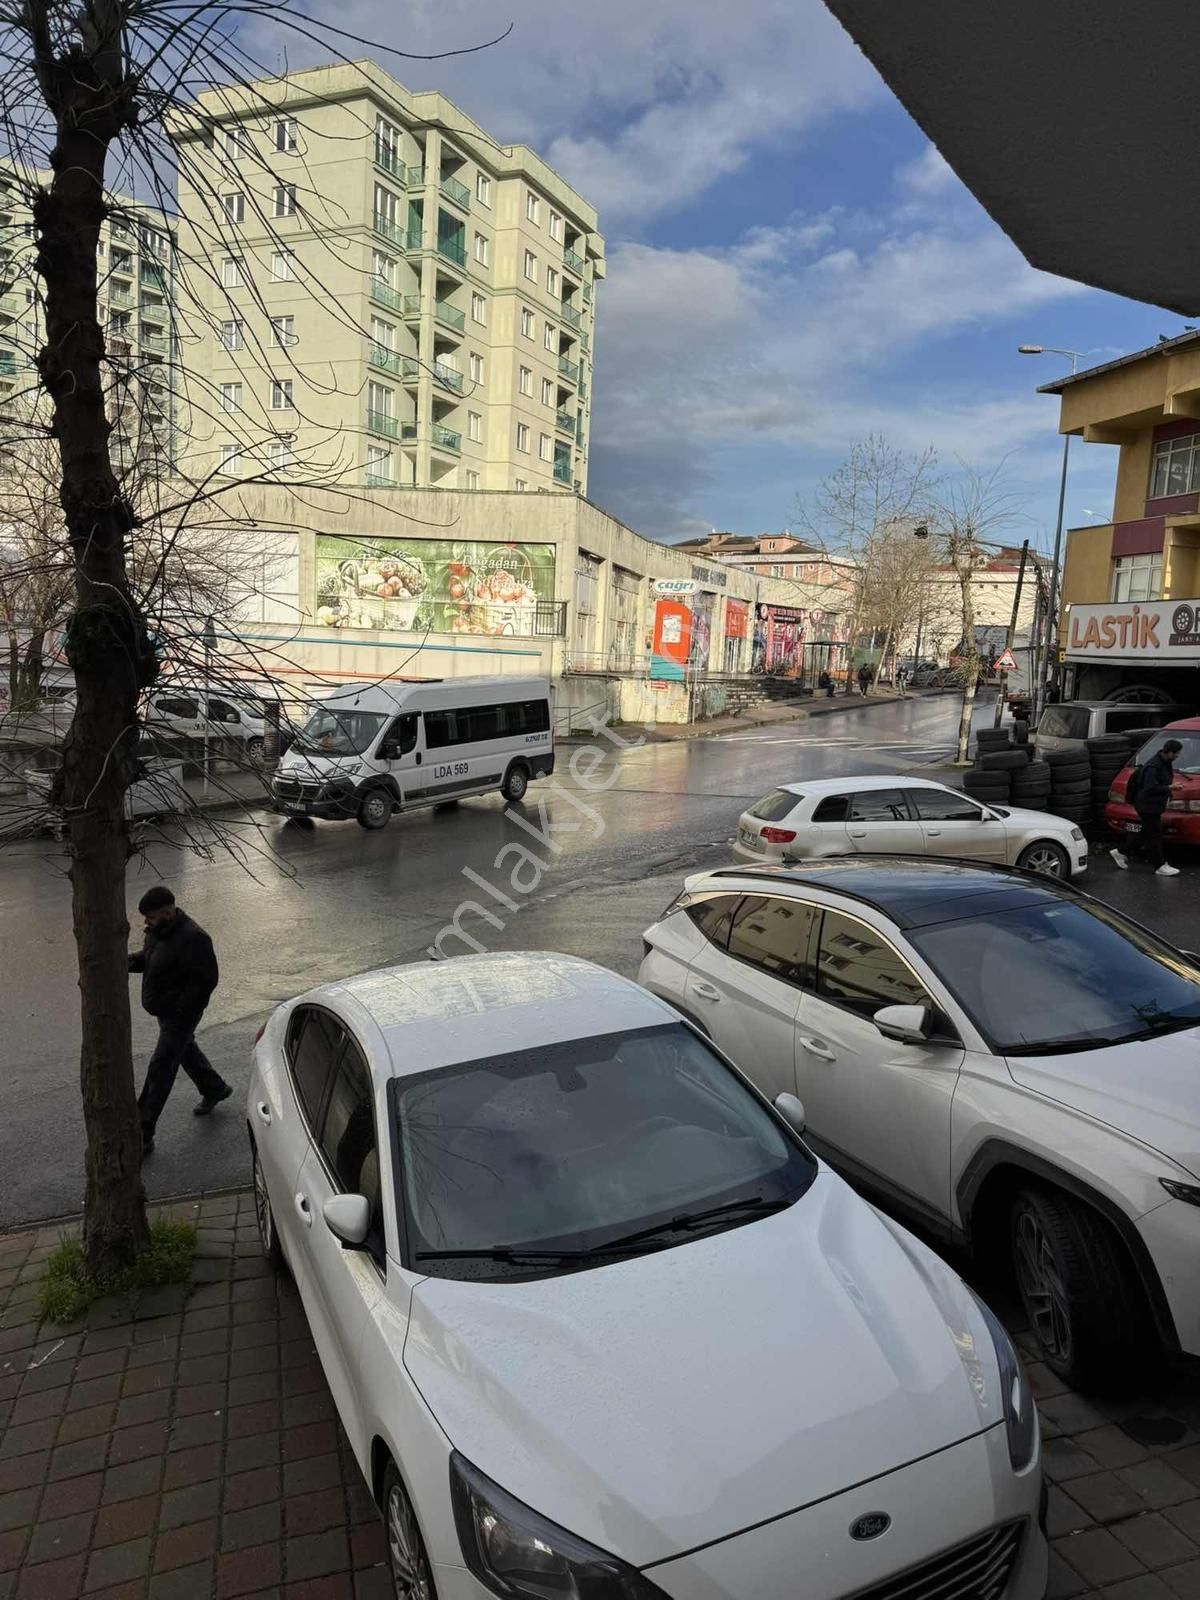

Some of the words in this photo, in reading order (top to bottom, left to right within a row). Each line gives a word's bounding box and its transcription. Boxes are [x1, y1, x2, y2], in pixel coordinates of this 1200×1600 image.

[1071, 605, 1160, 649] LASTİK
[433, 764, 453, 779] LDA
[454, 762, 469, 776] 569
